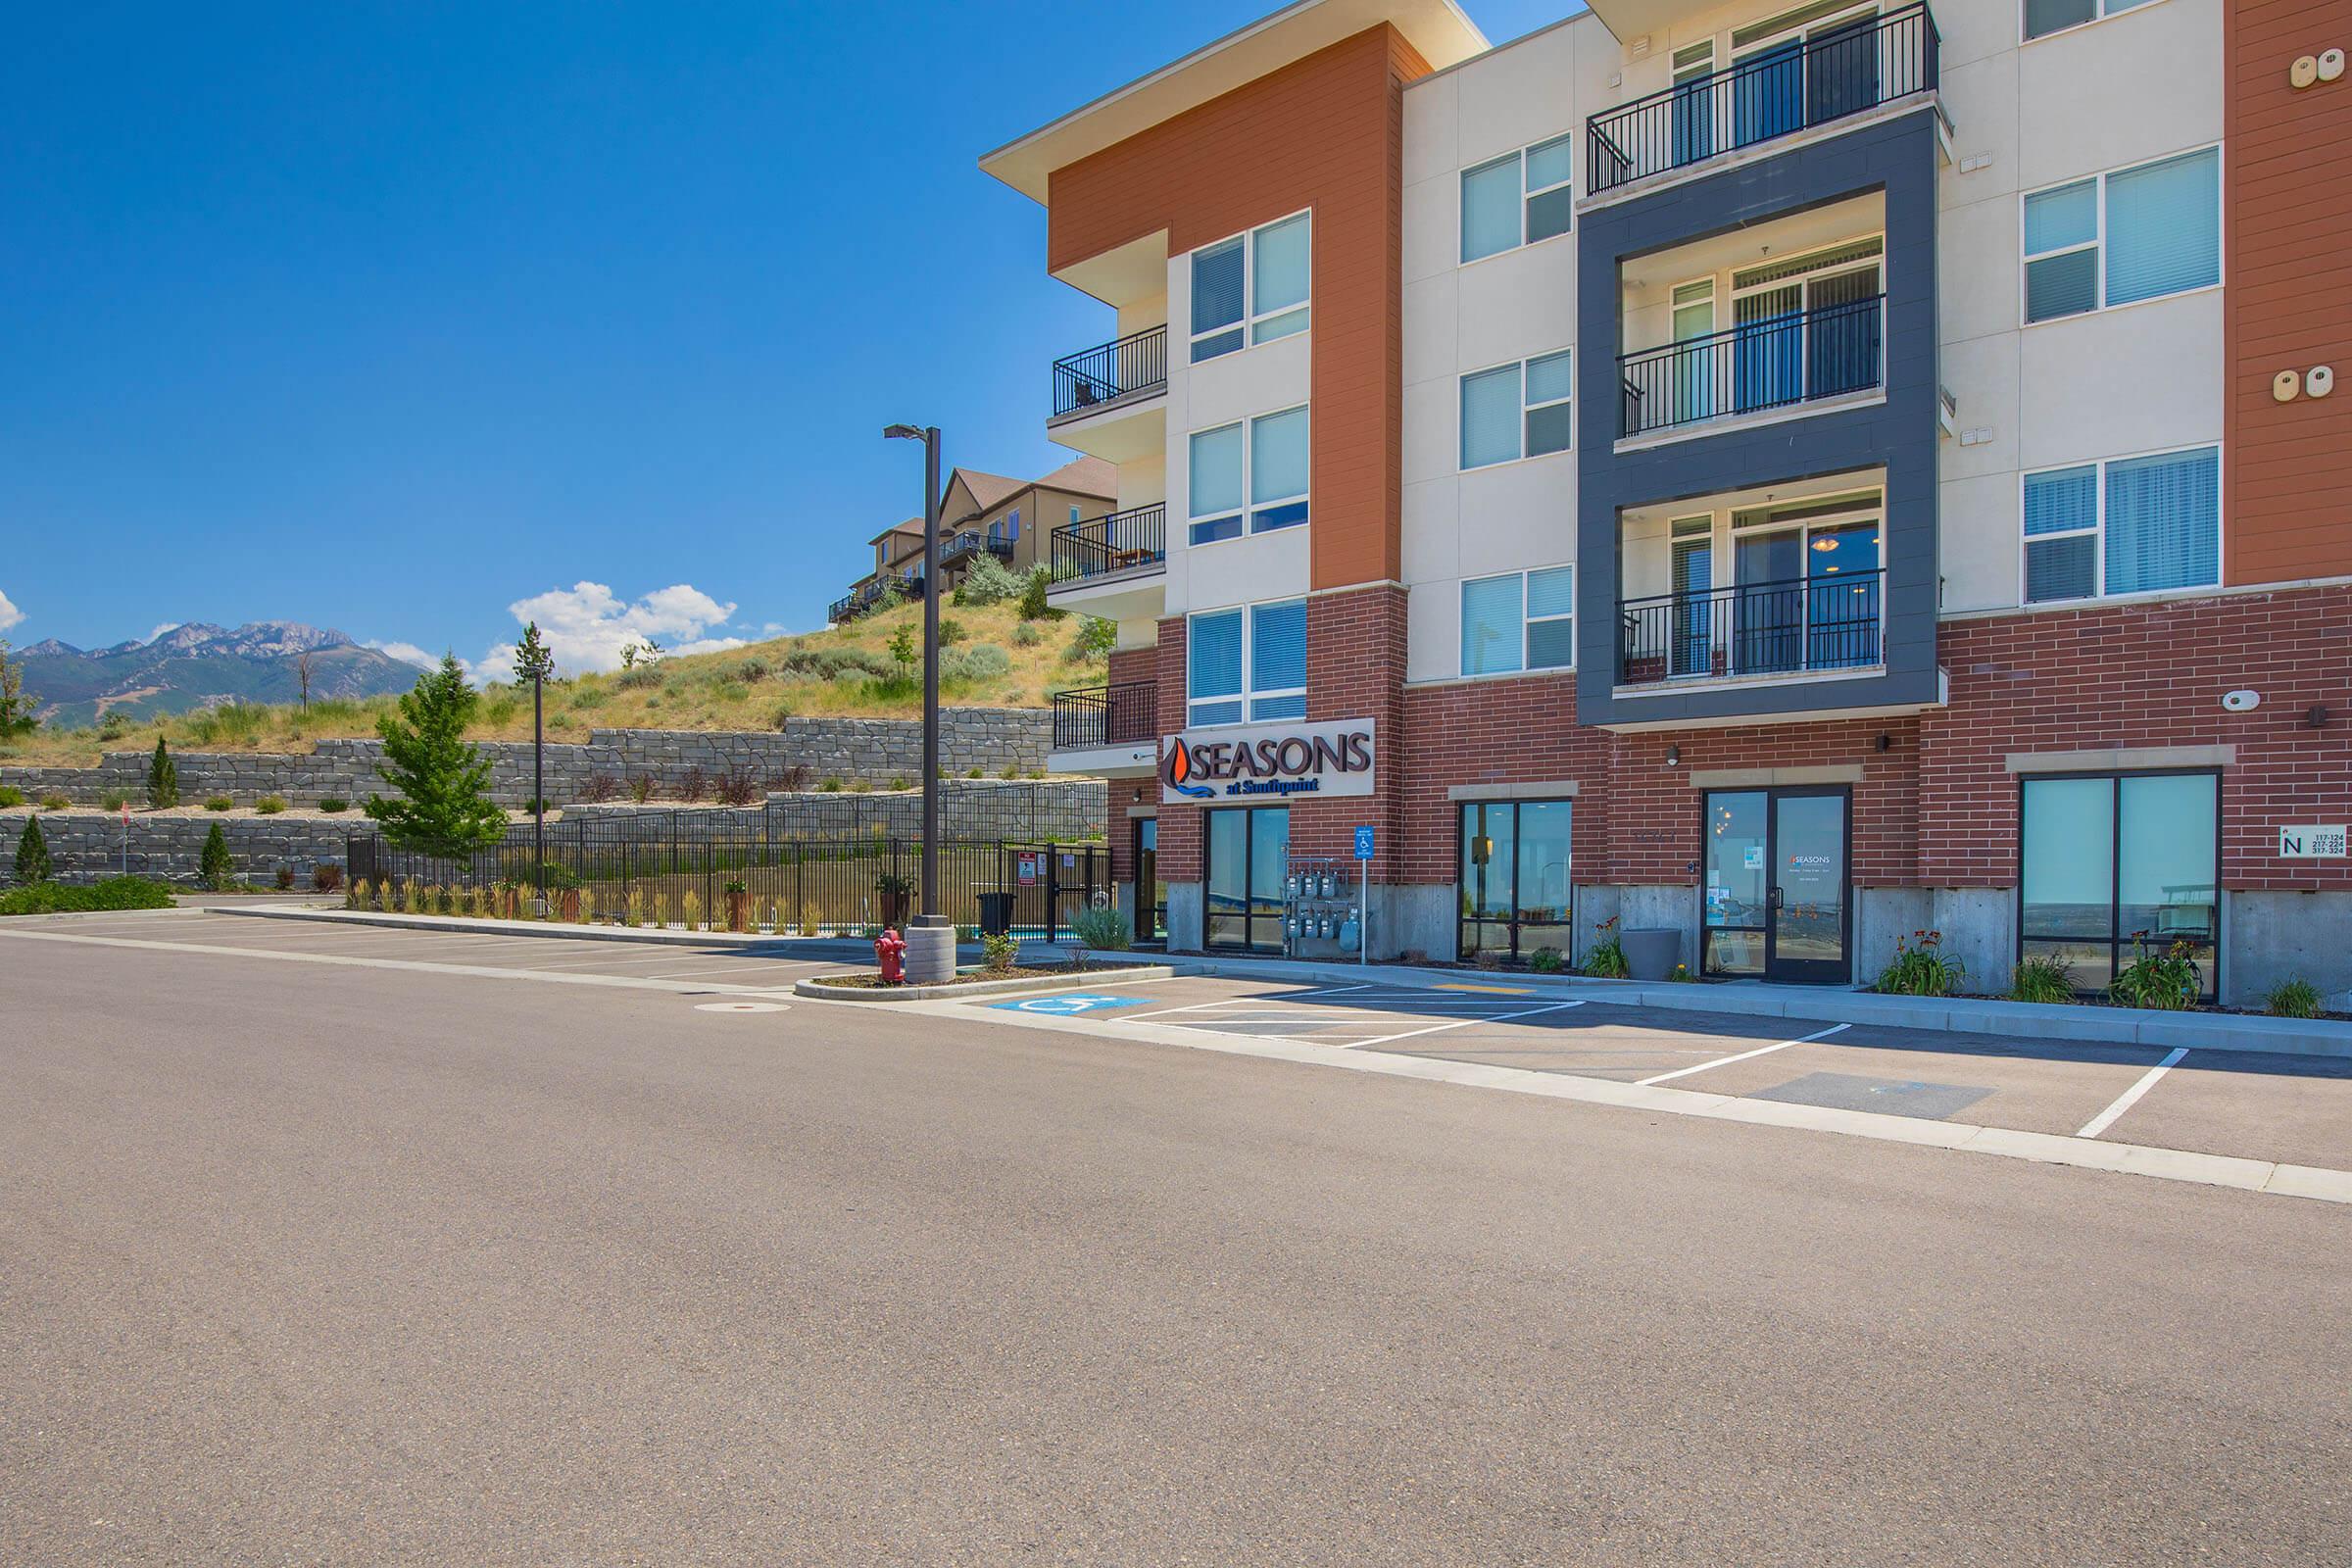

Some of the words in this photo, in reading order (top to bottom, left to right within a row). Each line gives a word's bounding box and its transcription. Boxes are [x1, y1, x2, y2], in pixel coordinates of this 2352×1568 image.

[1191, 732, 1371, 780] SEASONS
[1226, 782, 1242, 795] at
[1242, 777, 1320, 796] Southpoint
[2284, 837, 2302, 854] N
